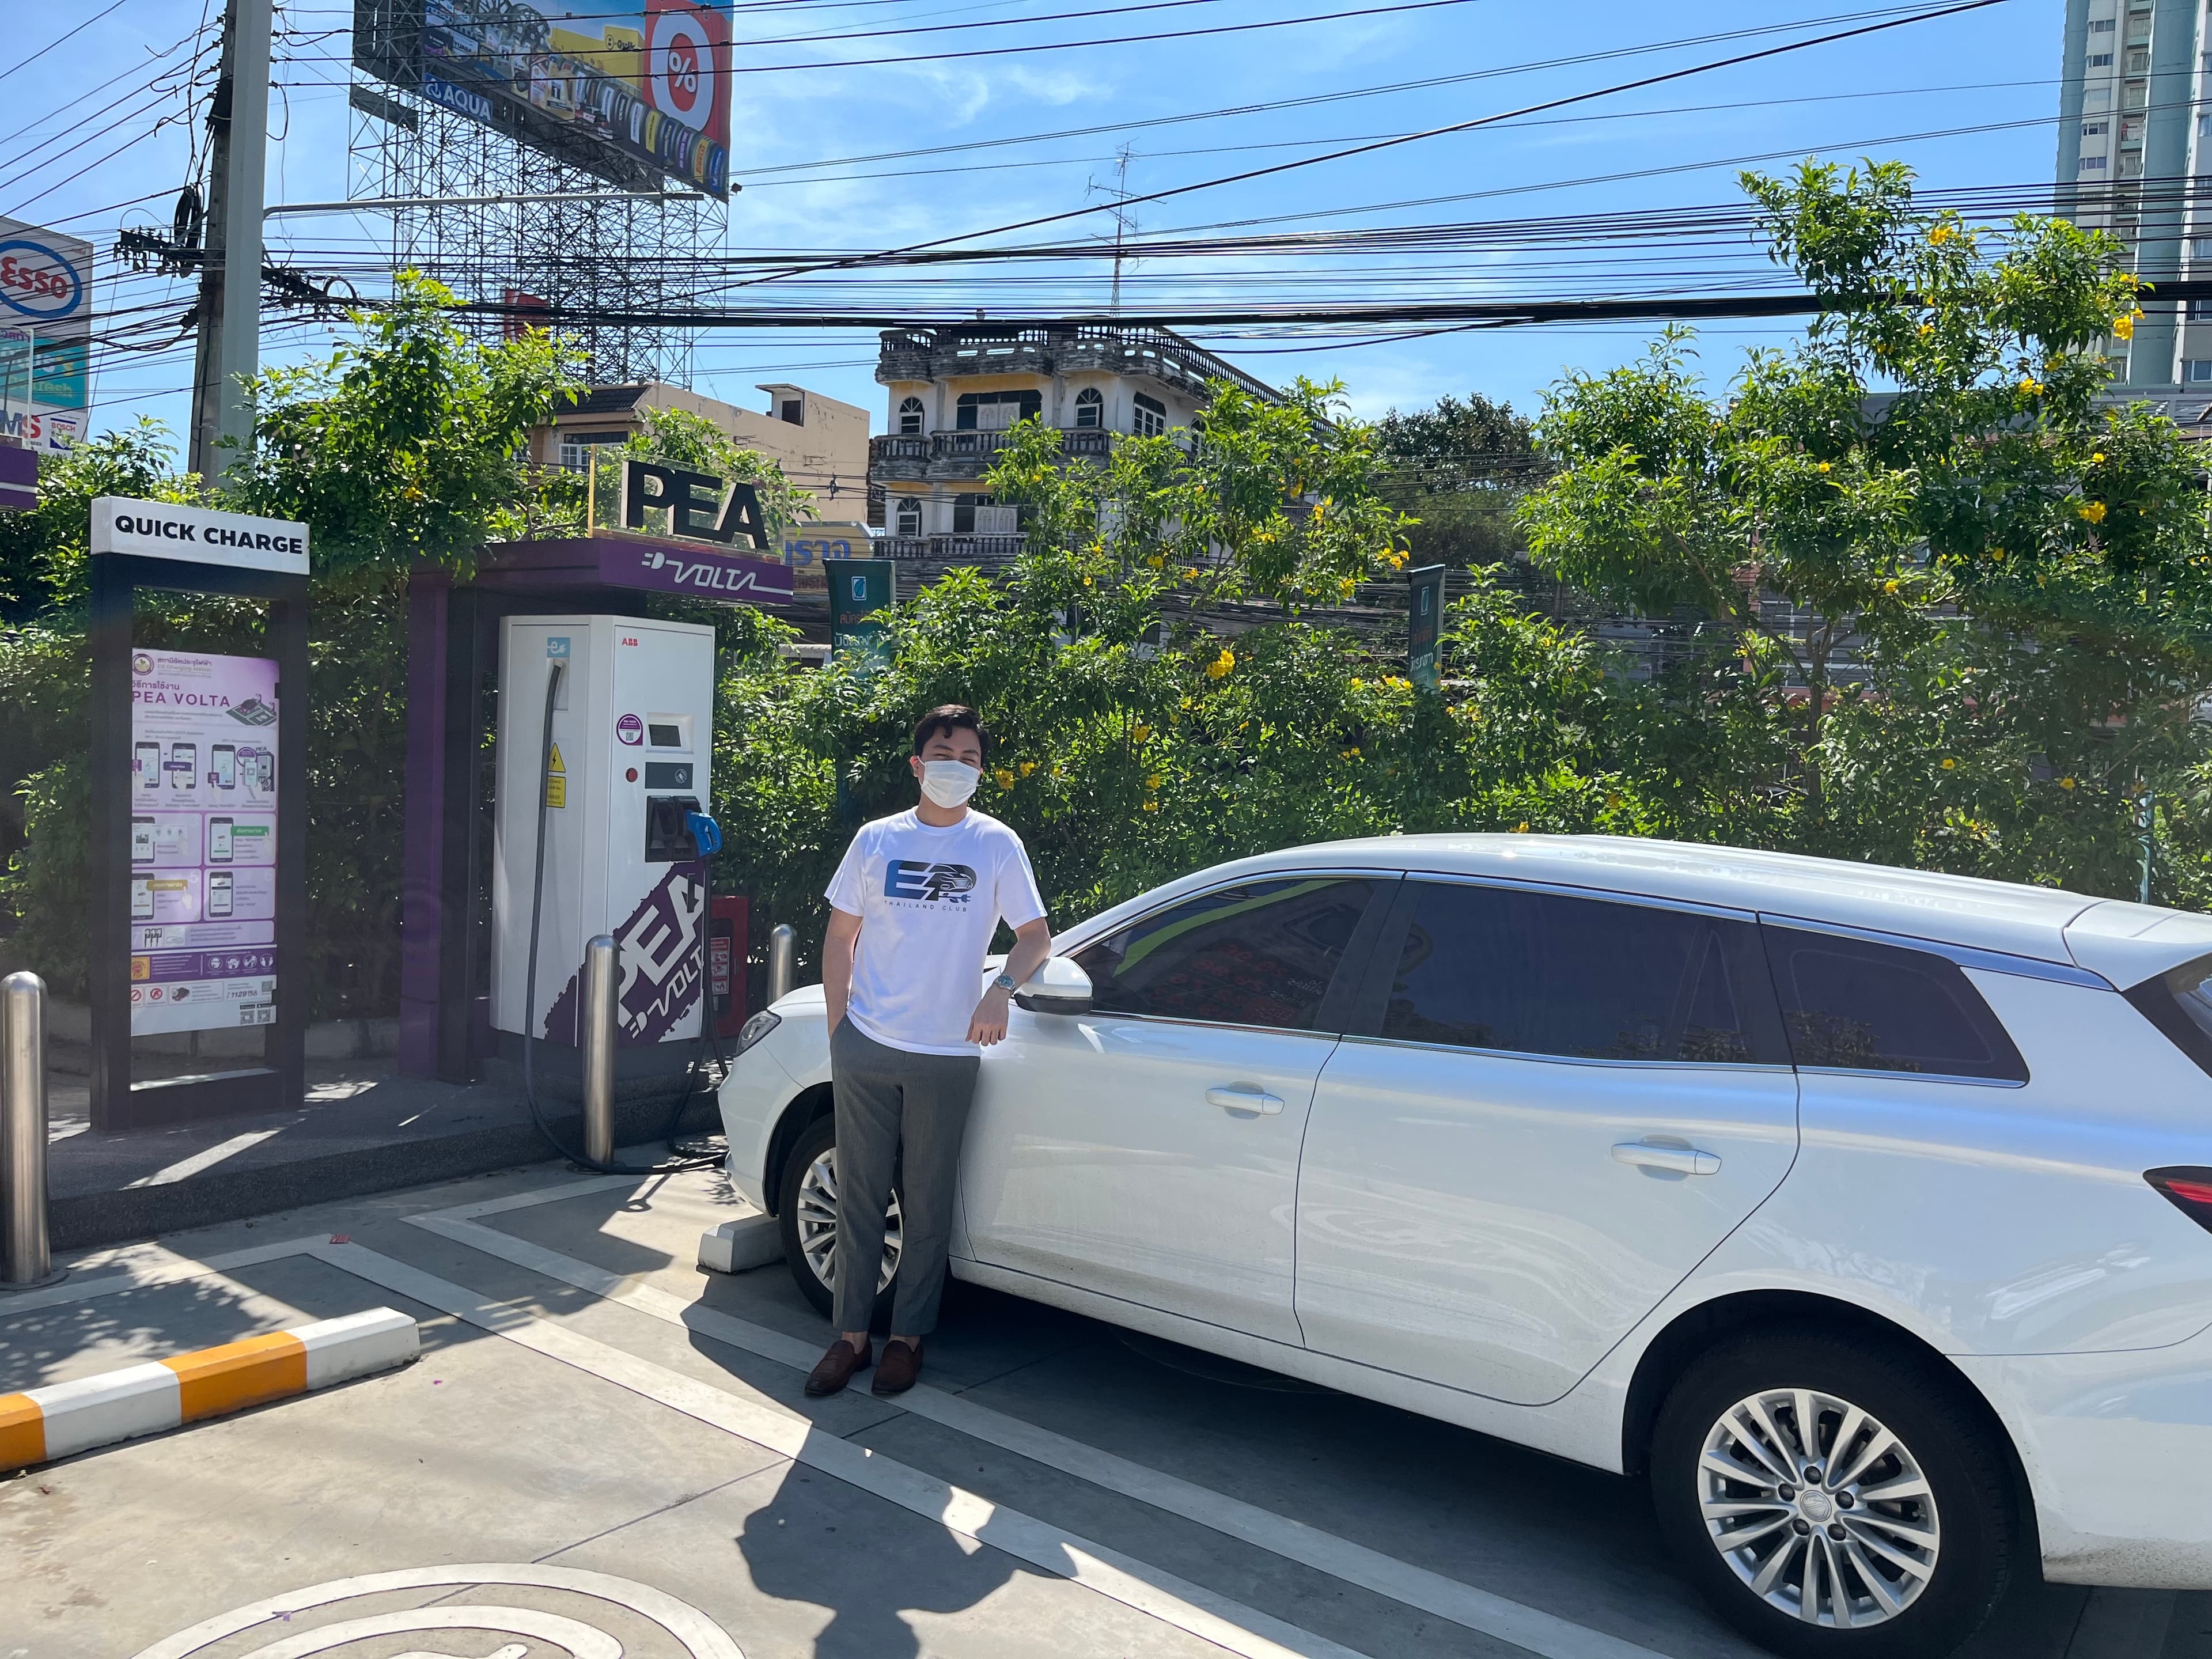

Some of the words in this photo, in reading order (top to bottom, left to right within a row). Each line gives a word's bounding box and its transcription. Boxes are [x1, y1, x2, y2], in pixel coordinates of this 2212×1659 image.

[443, 85, 490, 120] AQUA
[51, 422, 75, 432] BOSCH
[622, 460, 770, 550] PEA
[115, 516, 196, 541] QUICK
[203, 527, 302, 554] CHARGE
[666, 560, 762, 591] VOLTA
[622, 638, 638, 646] ABB
[132, 691, 166, 704] PEA
[173, 693, 230, 707] VOLTA
[885, 900, 934, 910] THAILAND
